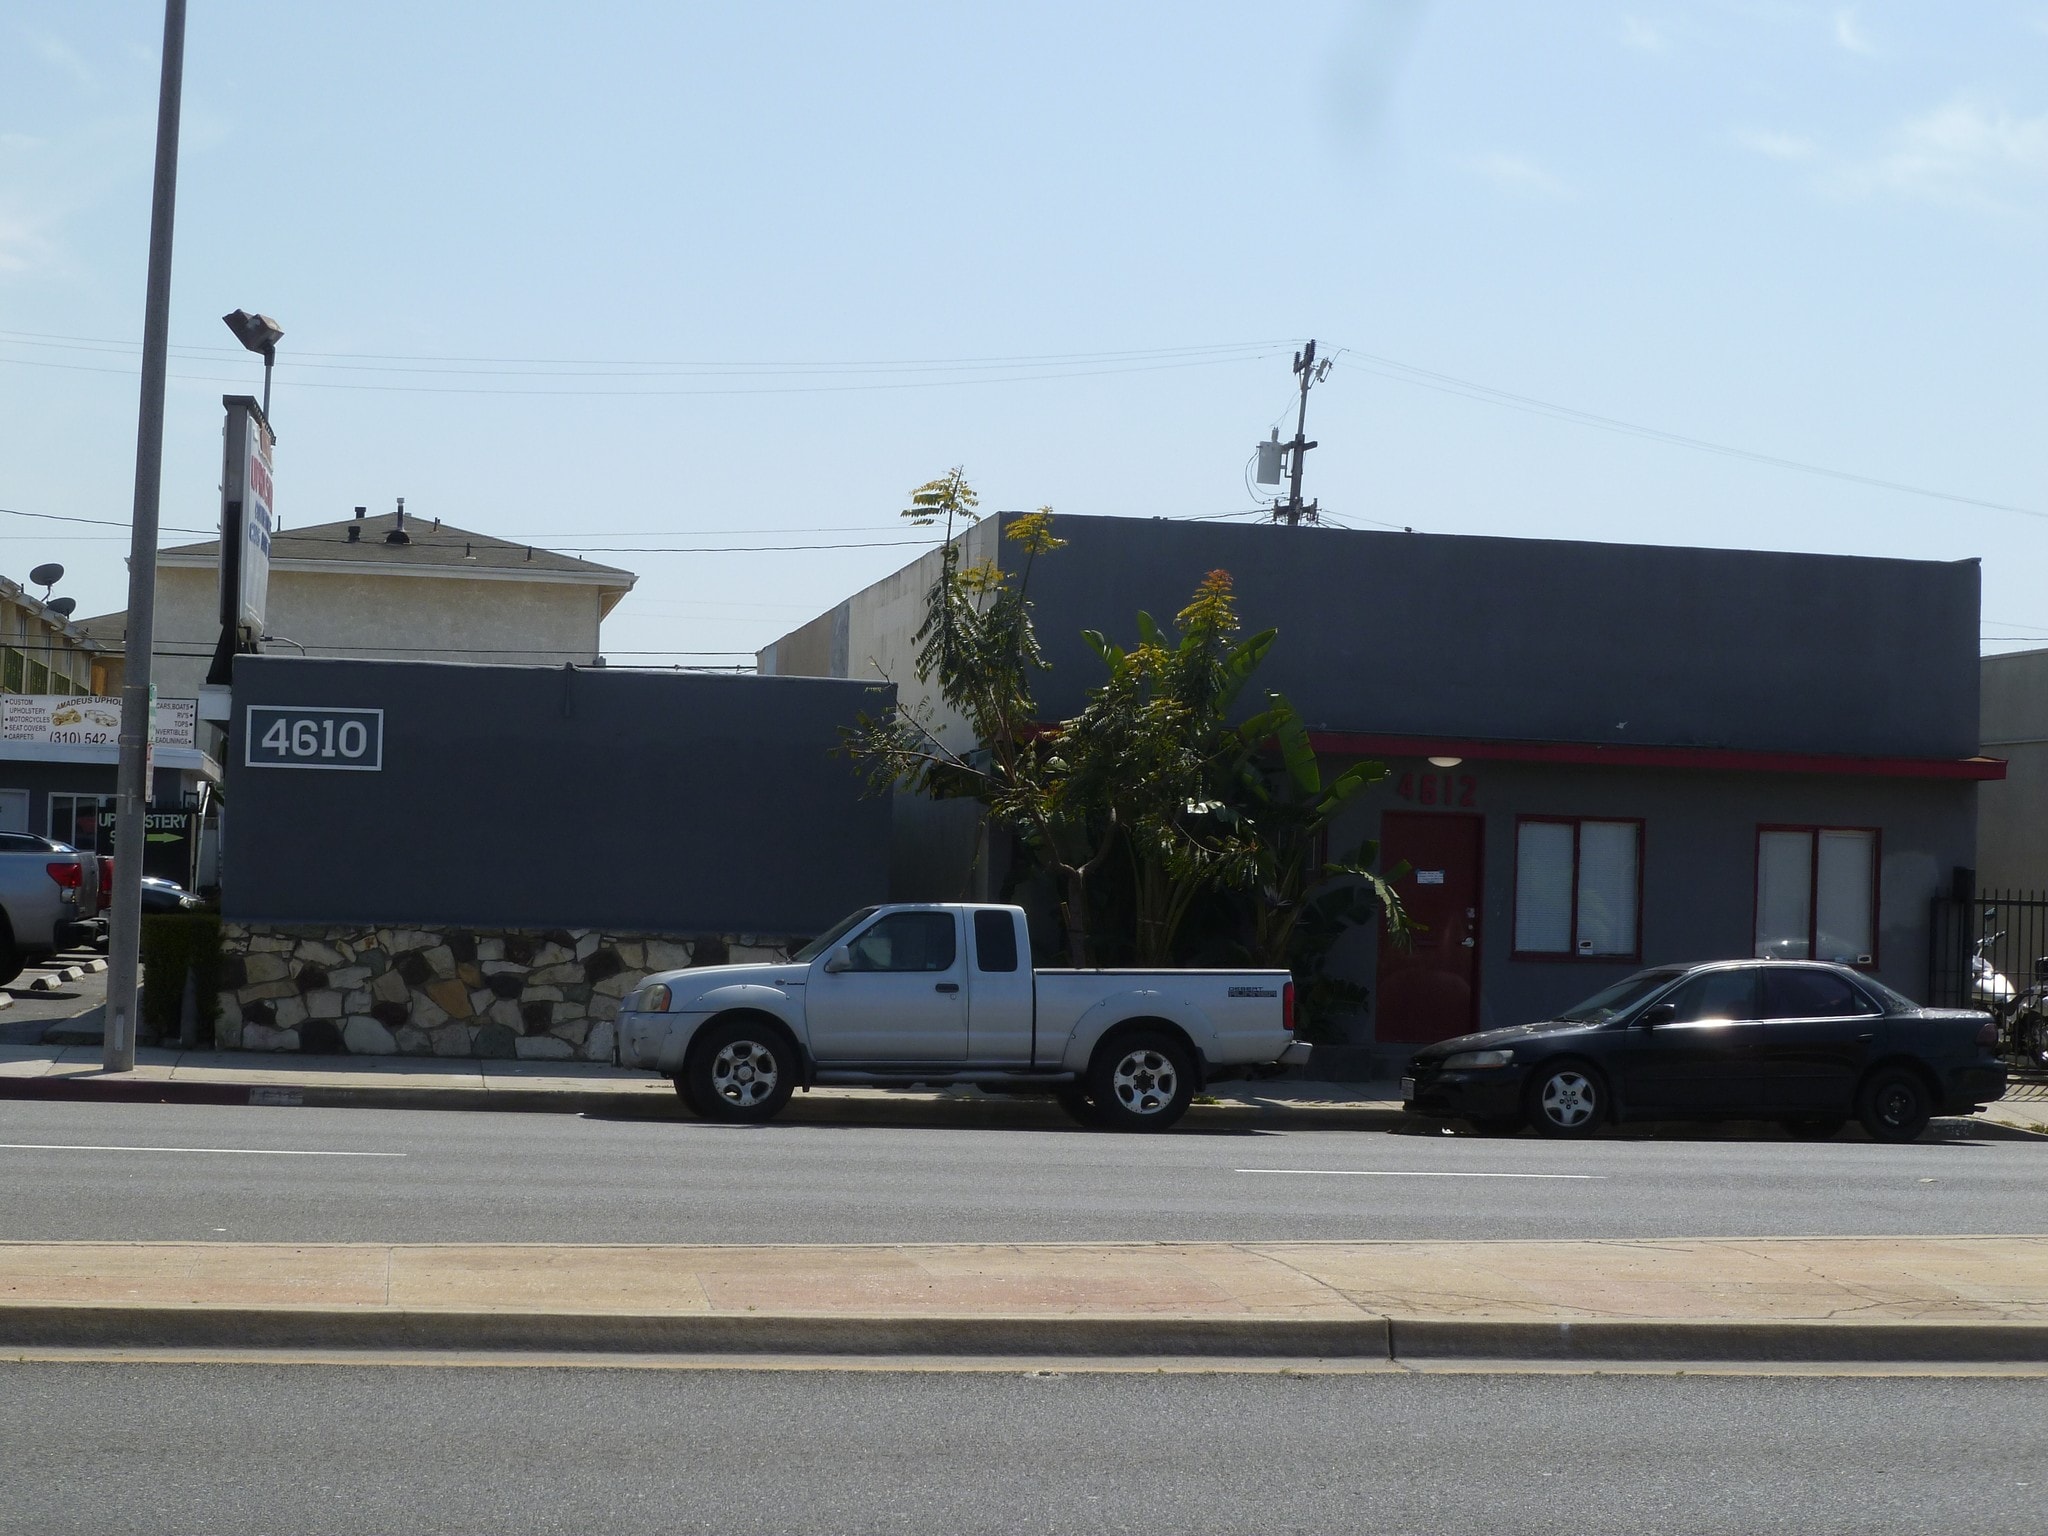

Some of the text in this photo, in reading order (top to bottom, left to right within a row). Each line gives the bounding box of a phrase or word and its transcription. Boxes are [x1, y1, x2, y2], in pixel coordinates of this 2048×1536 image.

[9, 698, 34, 706] CUSTOM
[55, 696, 123, 711] AMADEUS UPHOL
[9, 707, 46, 715] UPHOLSTERY
[9, 716, 51, 724] MOTORCYCLES
[174, 720, 189, 728] TOPS
[9, 724, 23, 732] SEAT
[155, 728, 189, 737] NVERTIBLES
[8, 733, 34, 741] CARPETS
[49, 731, 81, 744] (310)
[84, 732, 107, 744] 542
[155, 737, 188, 745] EADLININGS
[261, 718, 367, 758] 4610
[1398, 771, 1478, 807] 4612
[98, 812, 188, 829] UPSTERY
